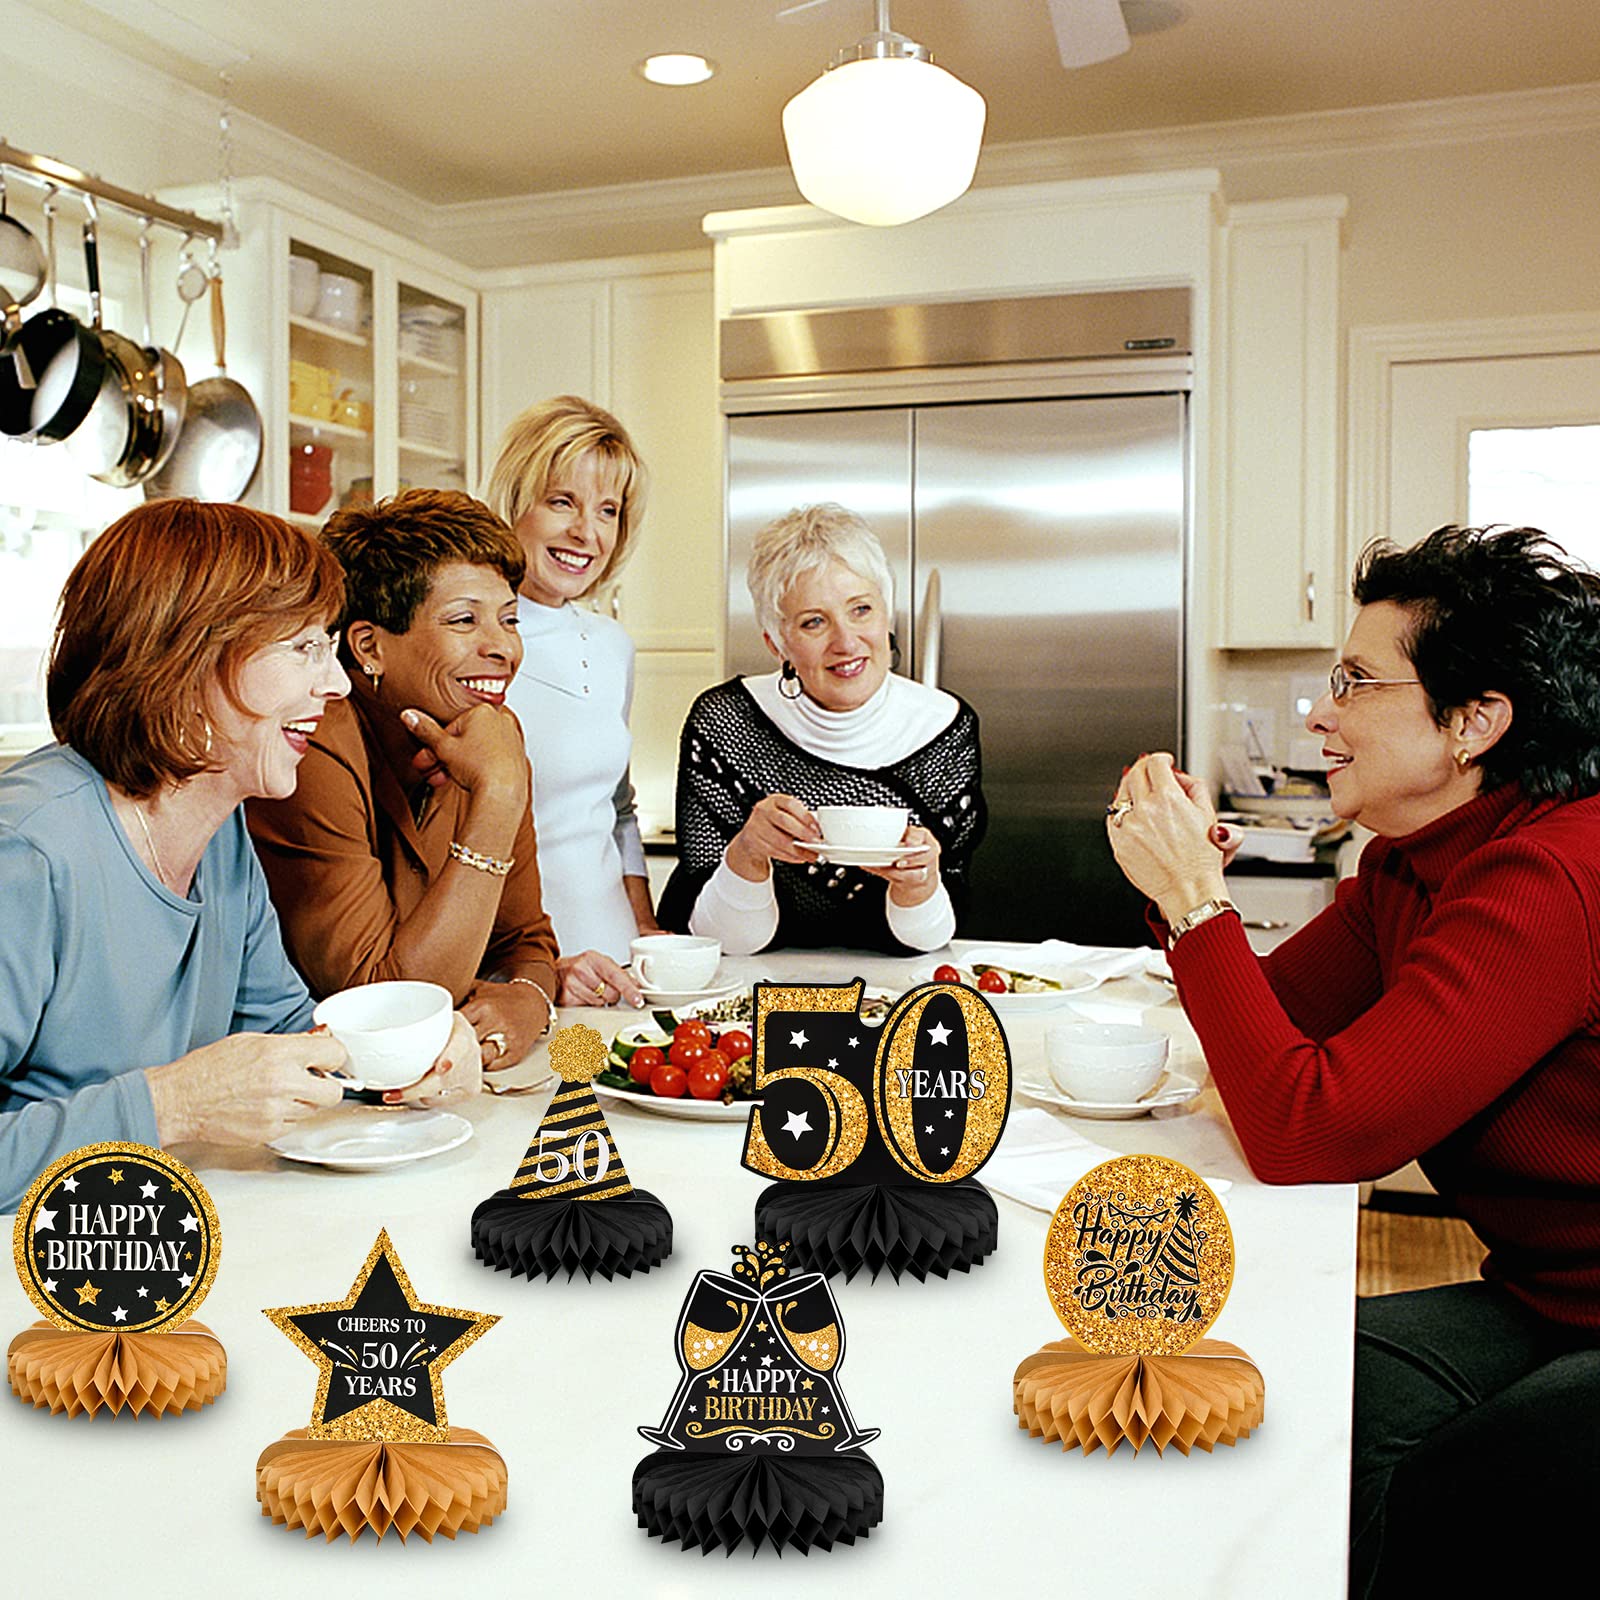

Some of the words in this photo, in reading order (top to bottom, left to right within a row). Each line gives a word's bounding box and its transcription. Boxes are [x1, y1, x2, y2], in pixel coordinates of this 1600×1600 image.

[741, 977, 1011, 1185] 50
[895, 1069, 986, 1100] YEARS
[535, 1130, 610, 1184] 50
[68, 1204, 166, 1236] HAPPY
[1073, 1202, 1169, 1265] Happy
[46, 1240, 187, 1272] BIRTHDAY
[1077, 1263, 1200, 1323] Birthday
[337, 1316, 400, 1334] CHEERS
[403, 1318, 426, 1334] TO
[361, 1342, 398, 1369] 50
[344, 1375, 417, 1397] YEARS
[721, 1368, 802, 1393] HAPPY
[704, 1396, 818, 1421] BIRTHDAY
